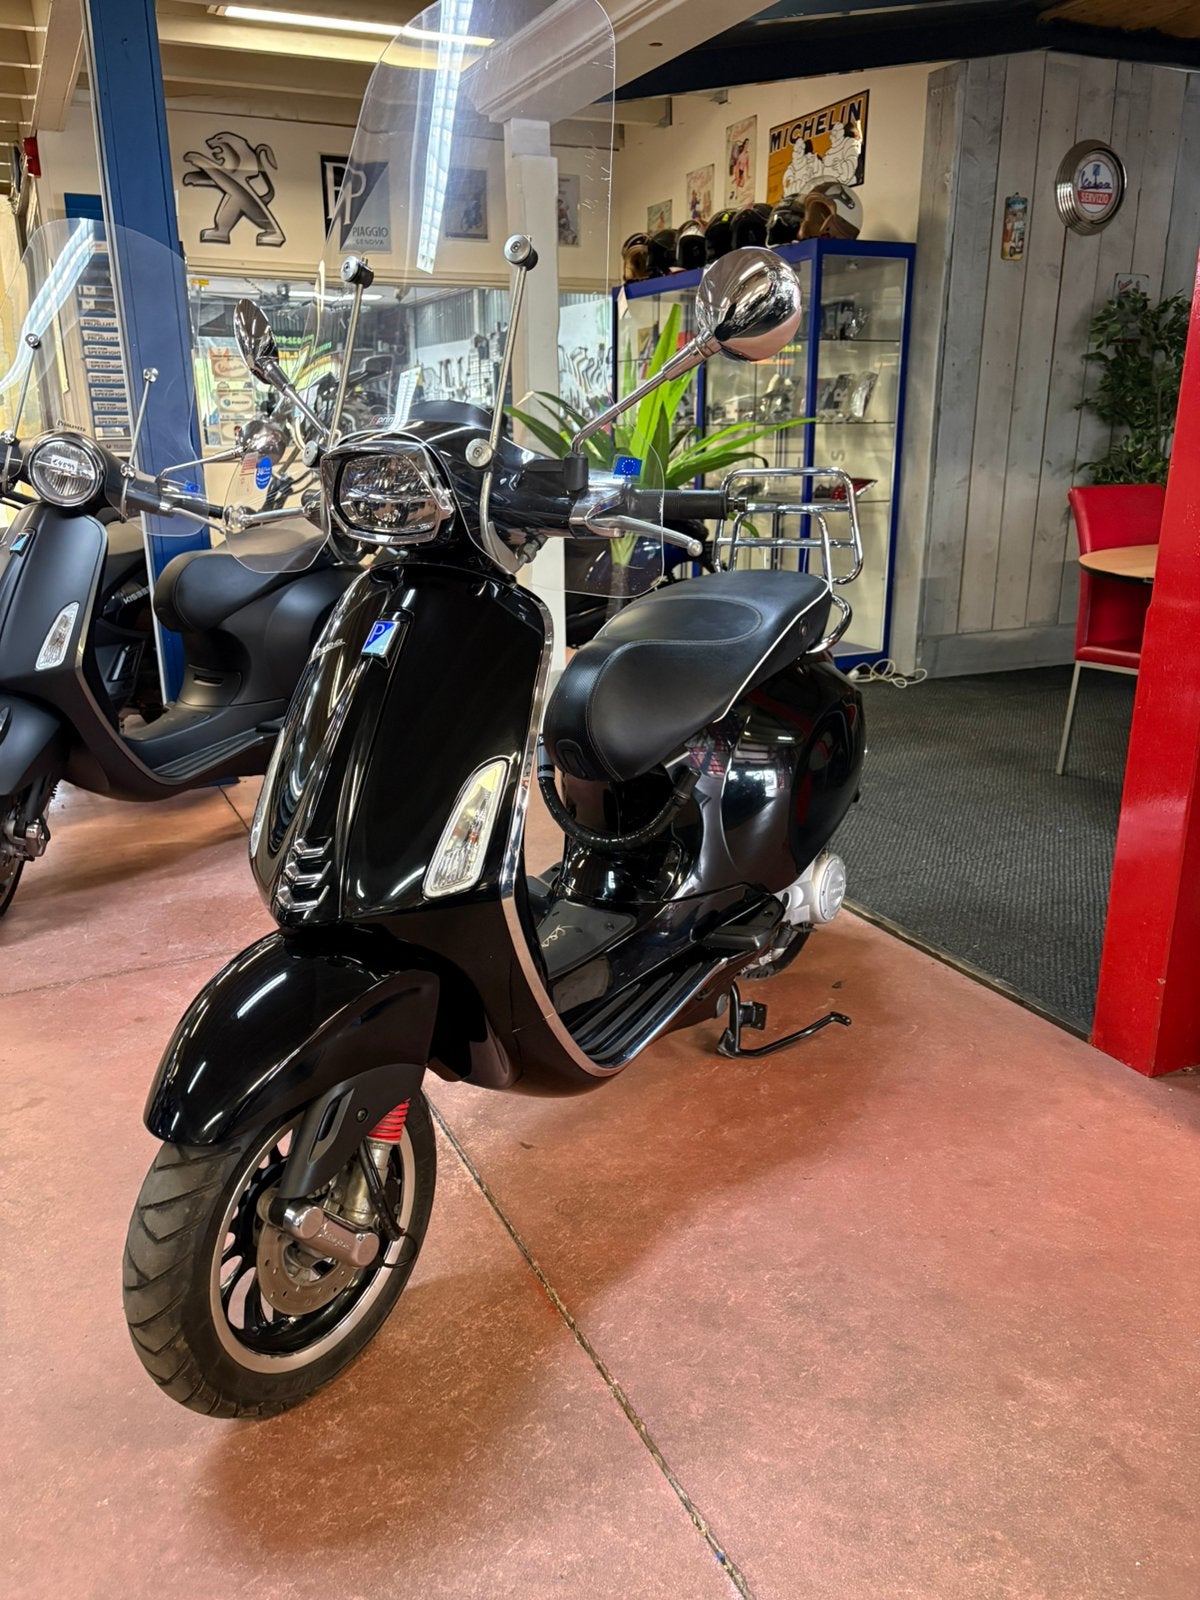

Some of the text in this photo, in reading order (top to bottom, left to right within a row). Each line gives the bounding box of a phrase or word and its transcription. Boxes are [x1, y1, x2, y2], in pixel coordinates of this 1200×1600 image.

[769, 99, 863, 154] MICHELIN
[1080, 191, 1110, 204] SERVIZIO
[352, 226, 389, 238] PIAGGIO
